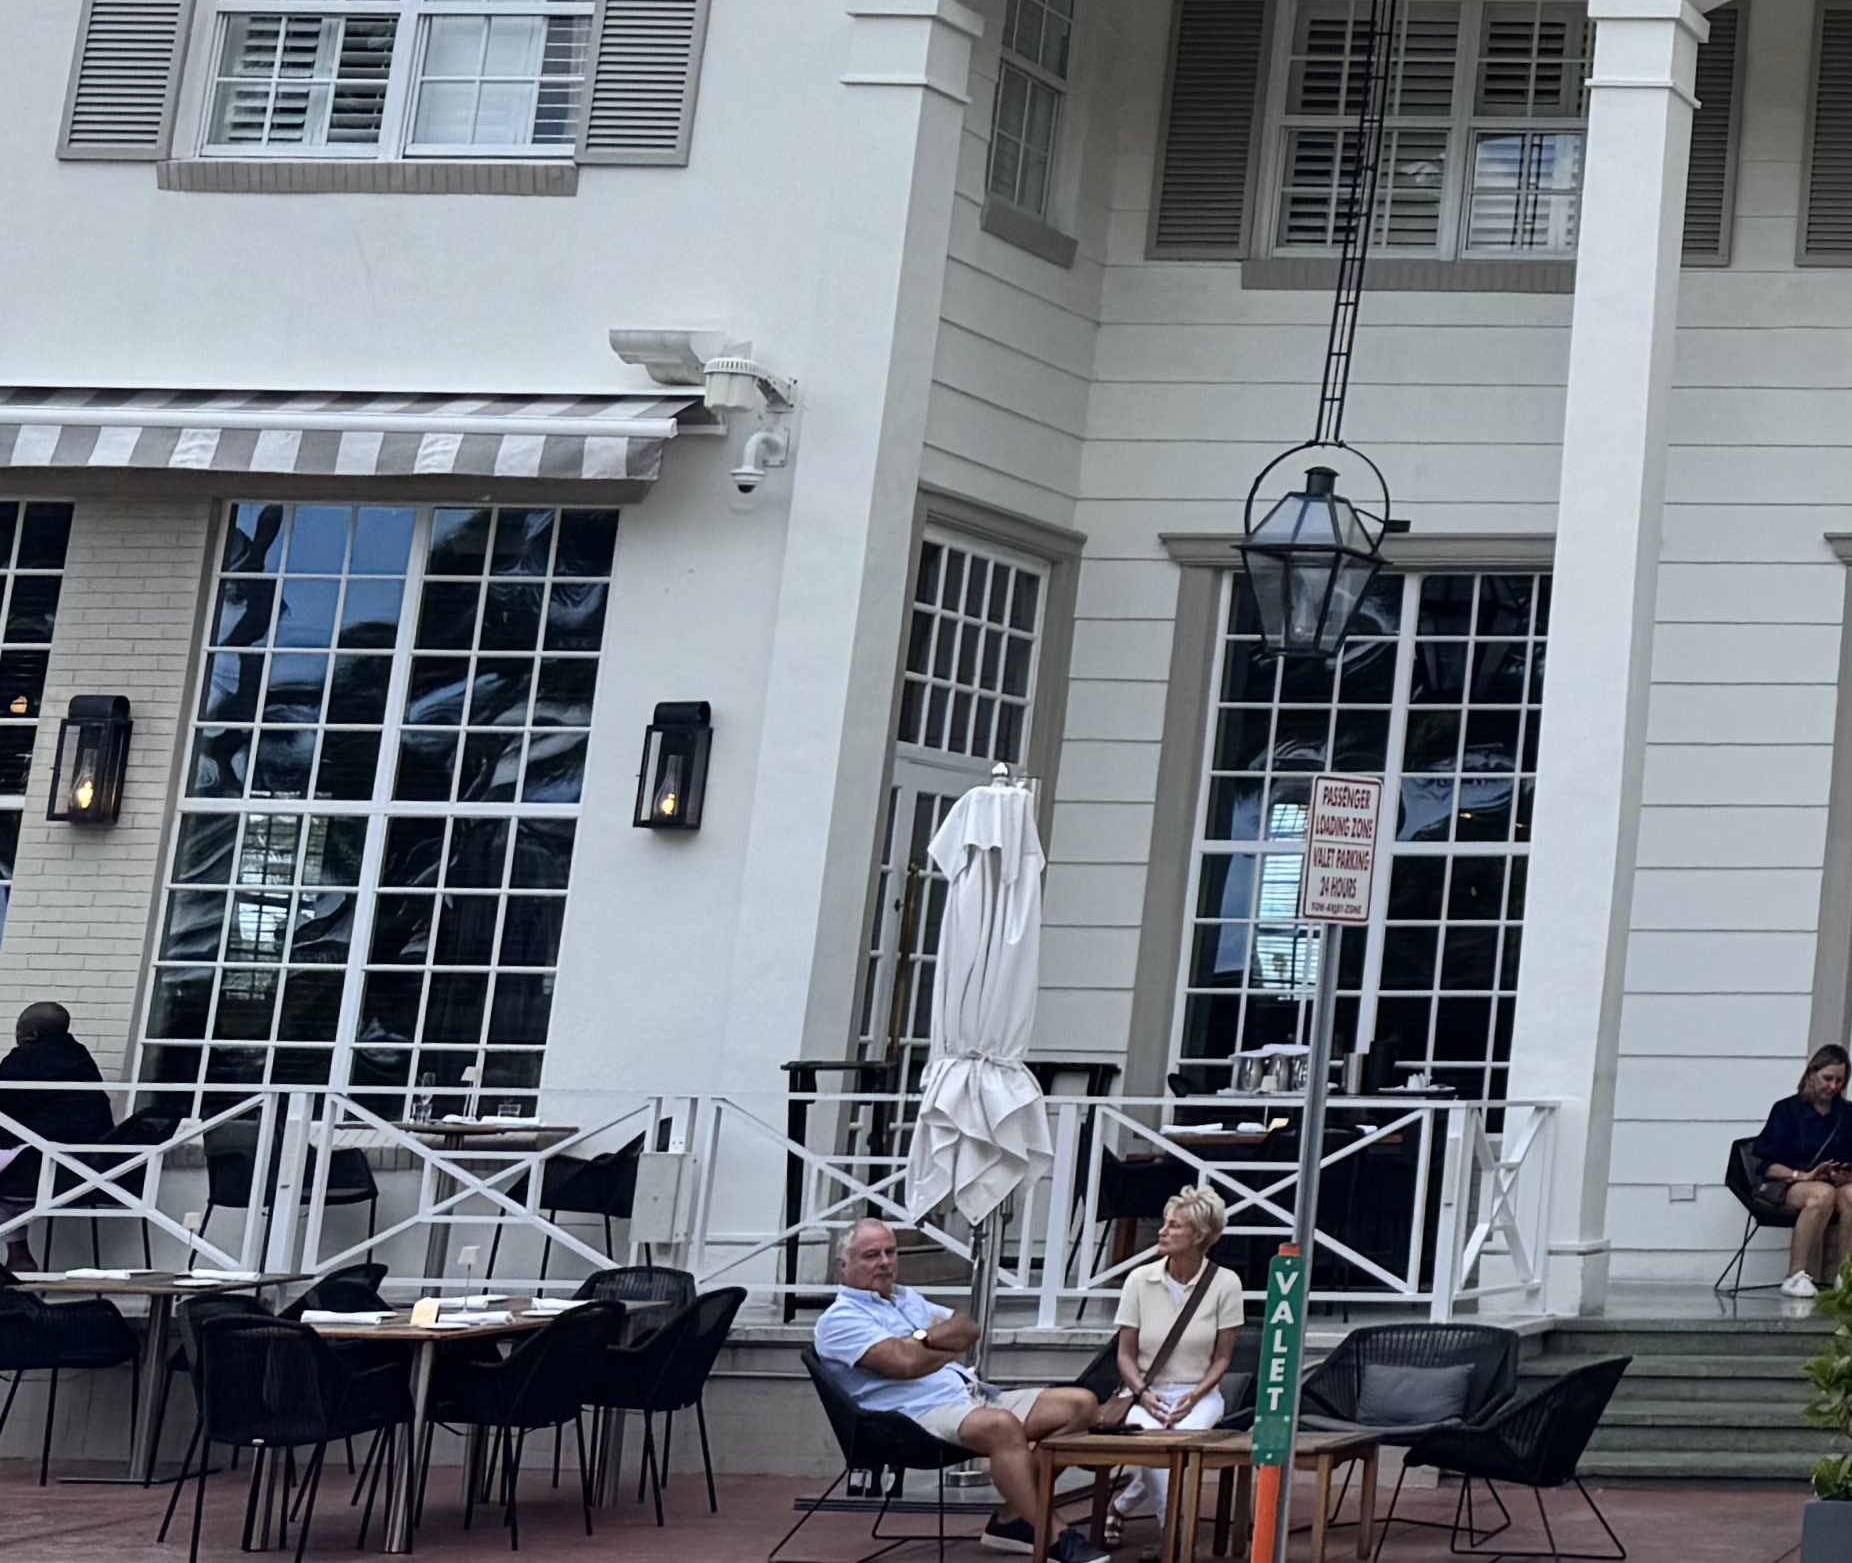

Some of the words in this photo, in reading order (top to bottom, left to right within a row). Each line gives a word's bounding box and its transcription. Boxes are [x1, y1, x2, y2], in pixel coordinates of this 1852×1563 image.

[1323, 785, 1371, 809] PASSENGER
[1315, 814, 1350, 837] LOADING
[1351, 817, 1373, 839] ZONE
[1313, 847, 1335, 868] VALET
[1336, 849, 1370, 871] PARKING
[1320, 876, 1330, 897] 24
[1331, 878, 1357, 899] HOURS
[1267, 1271, 1299, 1411] VALET
